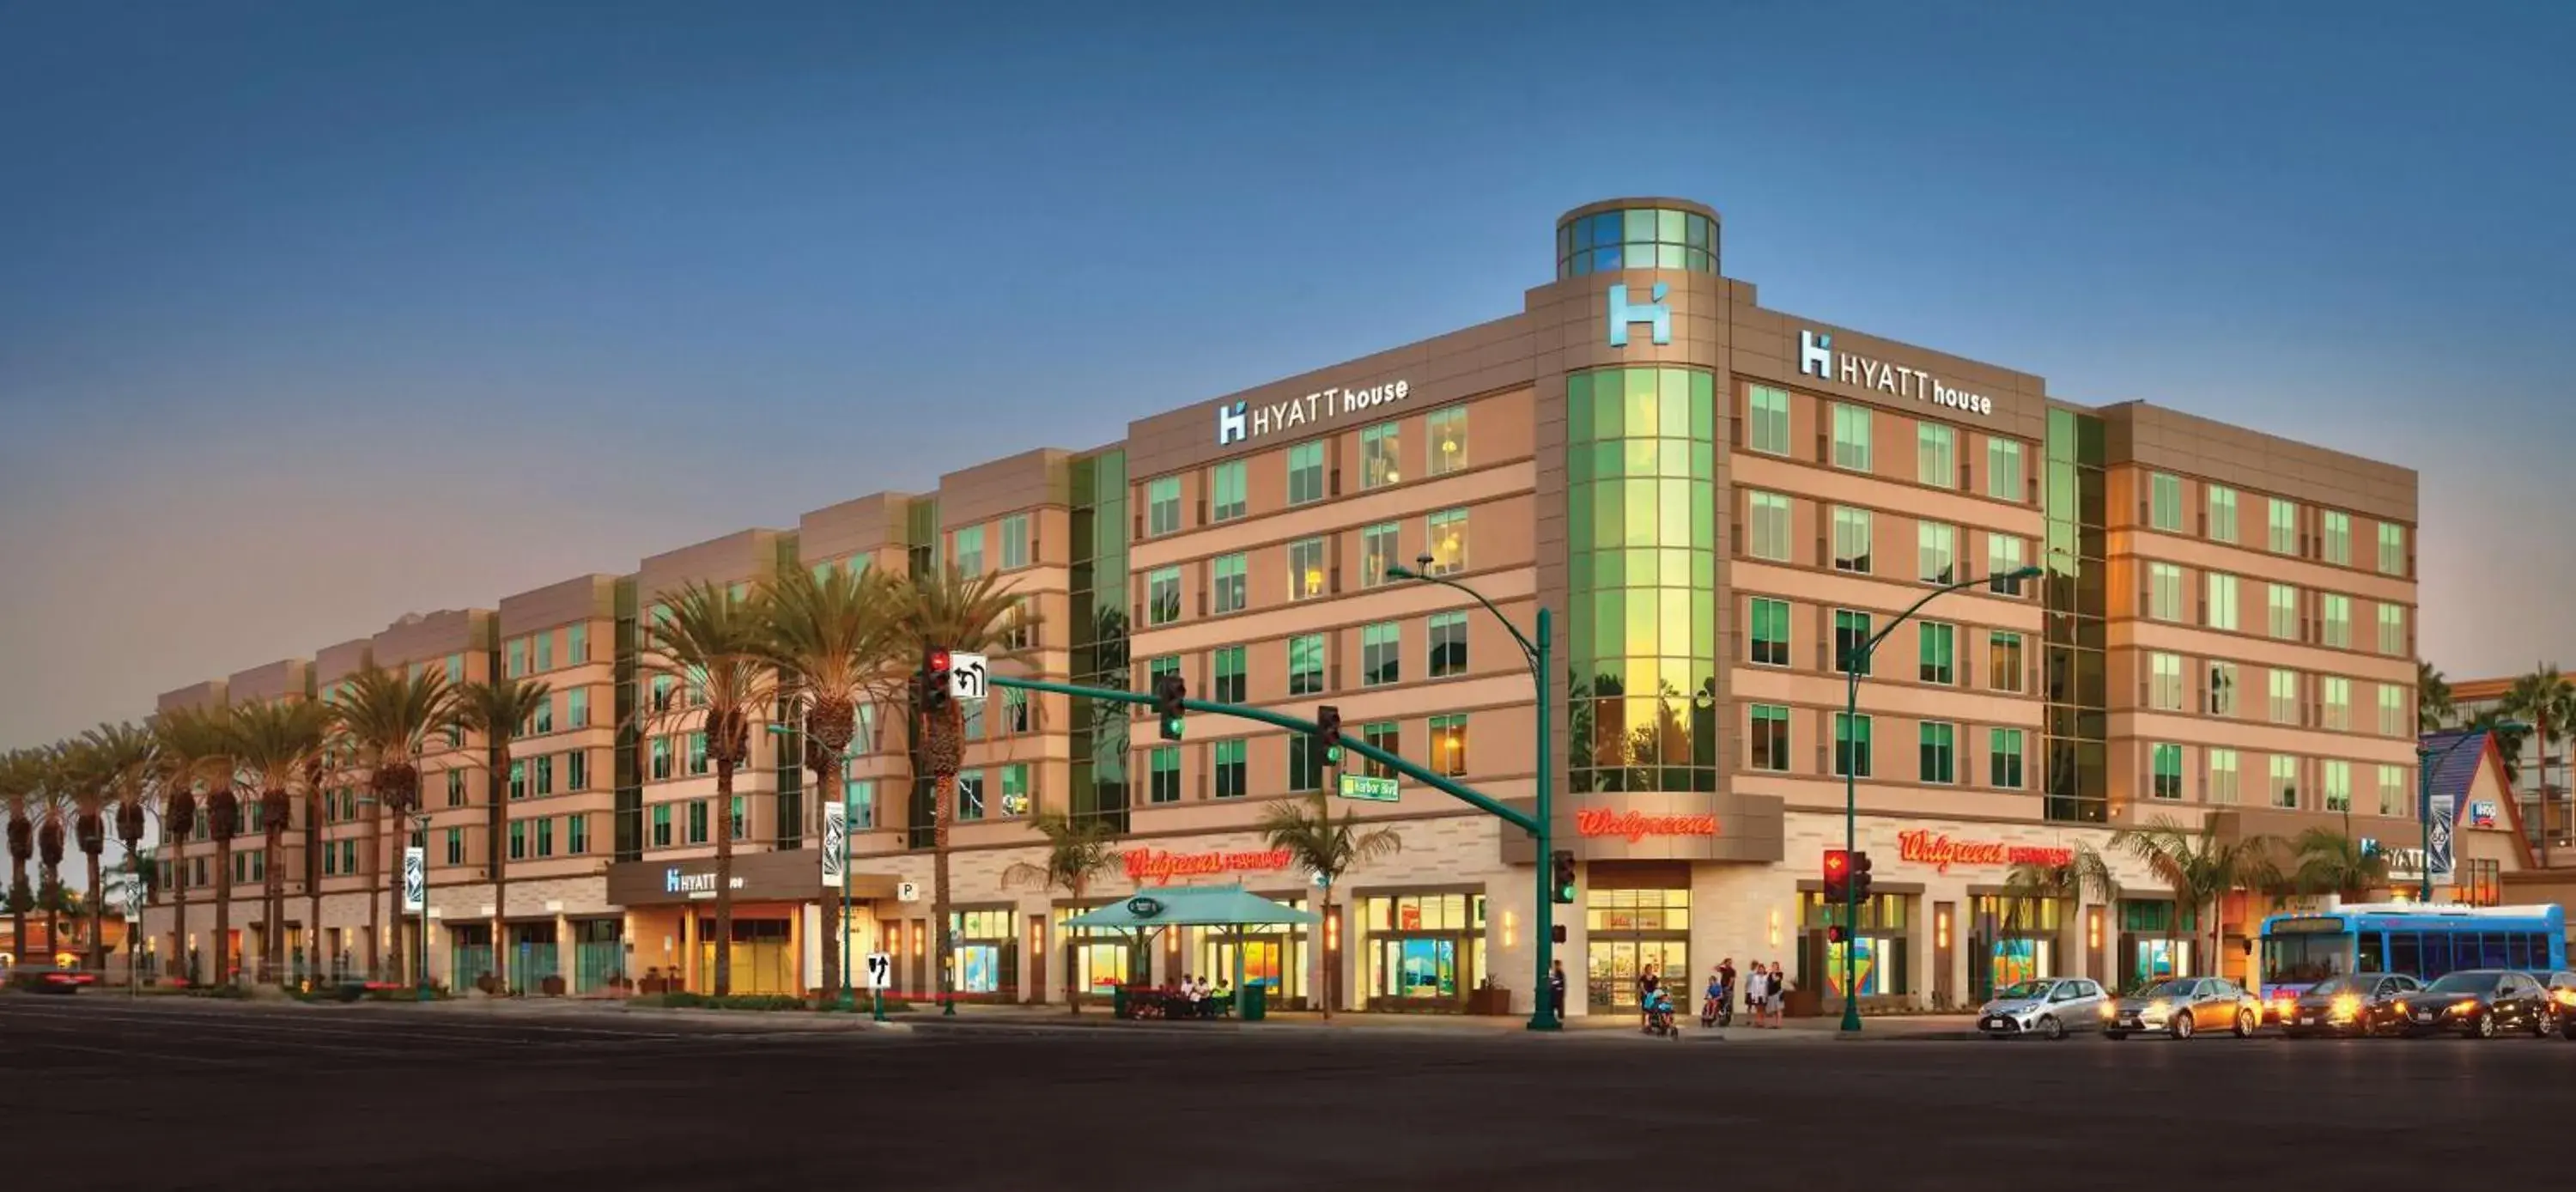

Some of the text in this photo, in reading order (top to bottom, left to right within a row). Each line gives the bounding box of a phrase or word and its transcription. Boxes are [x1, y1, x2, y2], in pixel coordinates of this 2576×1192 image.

[1838, 351, 1929, 400] HYATT
[1932, 378, 1992, 416] house
[1253, 386, 1340, 436] HYATT
[1343, 379, 1411, 414] house
[1577, 806, 1717, 842] Walgreens
[1124, 846, 1224, 886] Walgreens
[1899, 829, 2006, 874] Walgreens
[681, 873, 718, 892] HYATT
[904, 884, 913, 896] P
